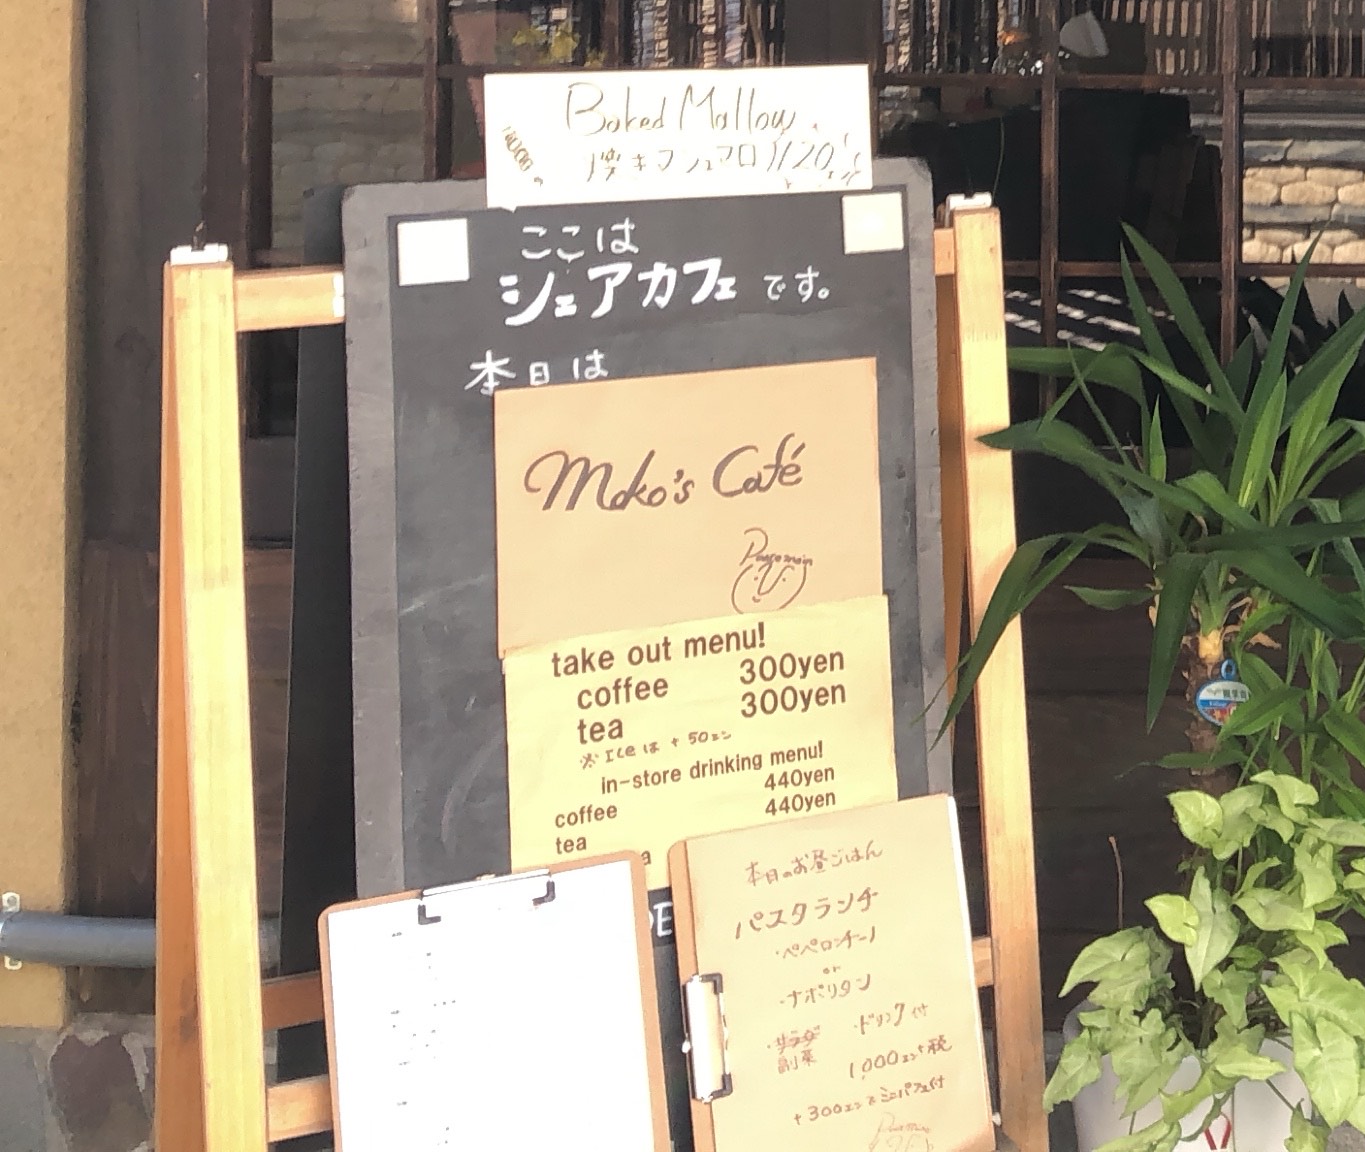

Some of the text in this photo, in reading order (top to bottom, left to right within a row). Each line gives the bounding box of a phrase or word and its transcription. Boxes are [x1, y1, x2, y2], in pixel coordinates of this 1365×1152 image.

[567, 82, 797, 136] Baked Mallow
[521, 217, 640, 260] ここは
[499, 257, 831, 326] シェアカフェ です。
[464, 348, 609, 394] 本日は
[713, 432, 806, 498] Café
[551, 622, 766, 679] take out menu!
[577, 650, 845, 711] coffee 300yen
[577, 682, 847, 746] tea 300yen
[601, 740, 824, 796] in-store drinking menu!
[555, 764, 835, 829] coffee 440yen
[555, 789, 836, 856] tea 440yen
[745, 840, 884, 887] 本日のお昼ごはん
[735, 886, 880, 939] パスタランチ
[822, 964, 841, 975] or
